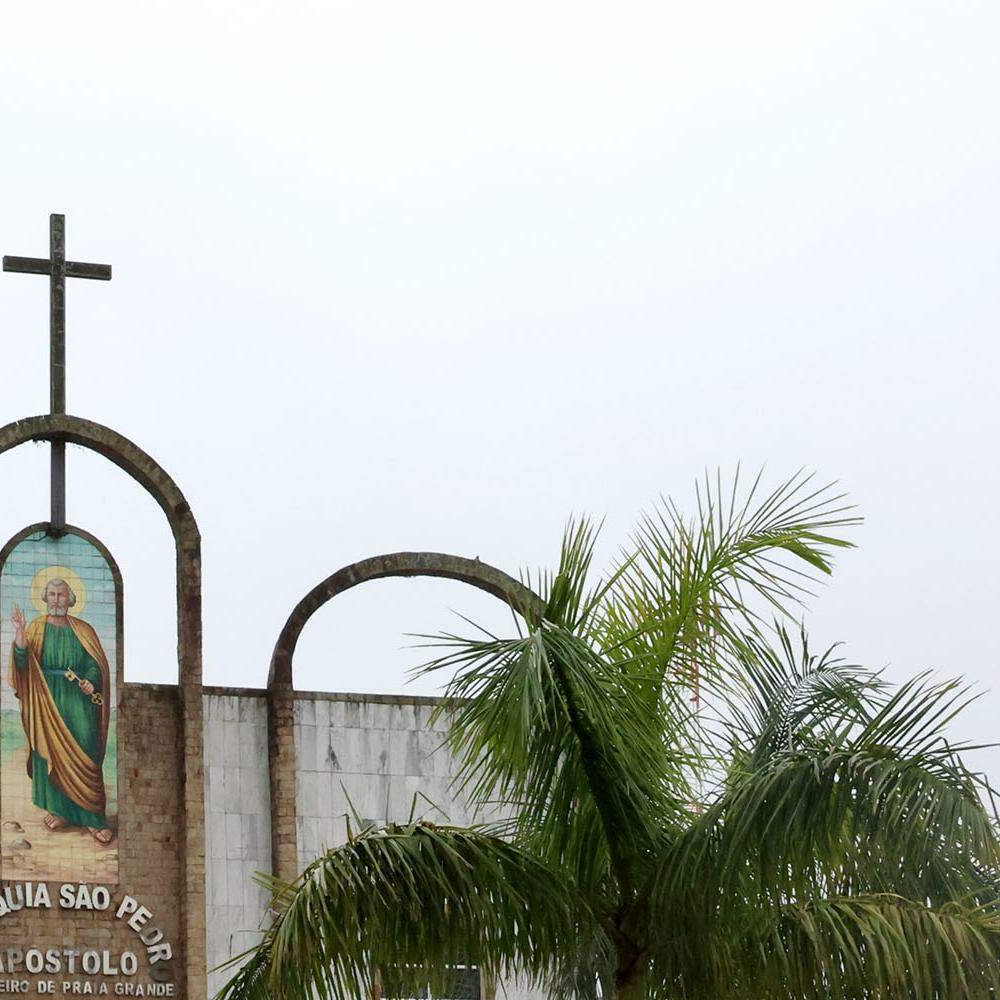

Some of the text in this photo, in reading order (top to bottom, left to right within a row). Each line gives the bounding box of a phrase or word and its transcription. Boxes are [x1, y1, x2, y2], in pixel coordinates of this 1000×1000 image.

[59, 880, 110, 911] SÃO
[116, 894, 174, 983] PEDRO
[37, 981, 57, 993] DE
[62, 982, 109, 995] PRAIA
[114, 984, 175, 997] GRANDE
